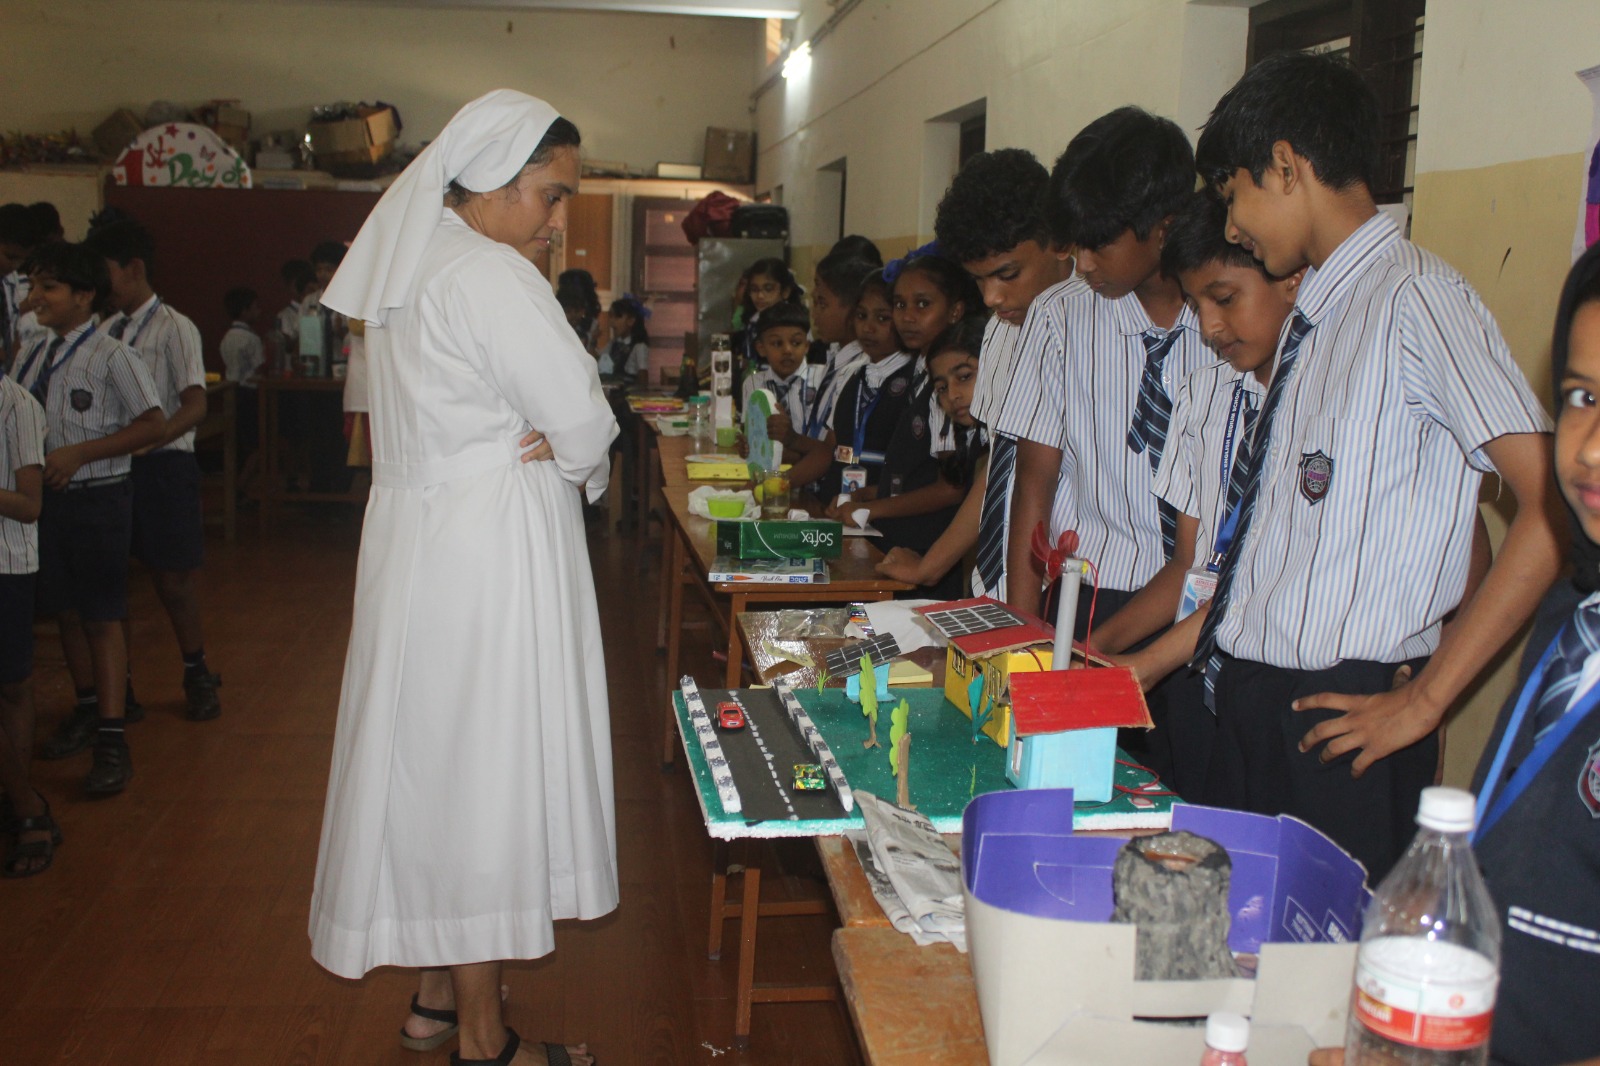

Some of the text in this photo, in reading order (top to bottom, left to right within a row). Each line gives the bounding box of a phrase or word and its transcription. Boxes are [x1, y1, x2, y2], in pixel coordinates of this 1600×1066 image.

[168, 153, 217, 187] Day
[1227, 412, 1235, 439] MEDIUM
[1232, 387, 1241, 411] SCHOOL
[774, 532, 799, 540] PREMIUM
